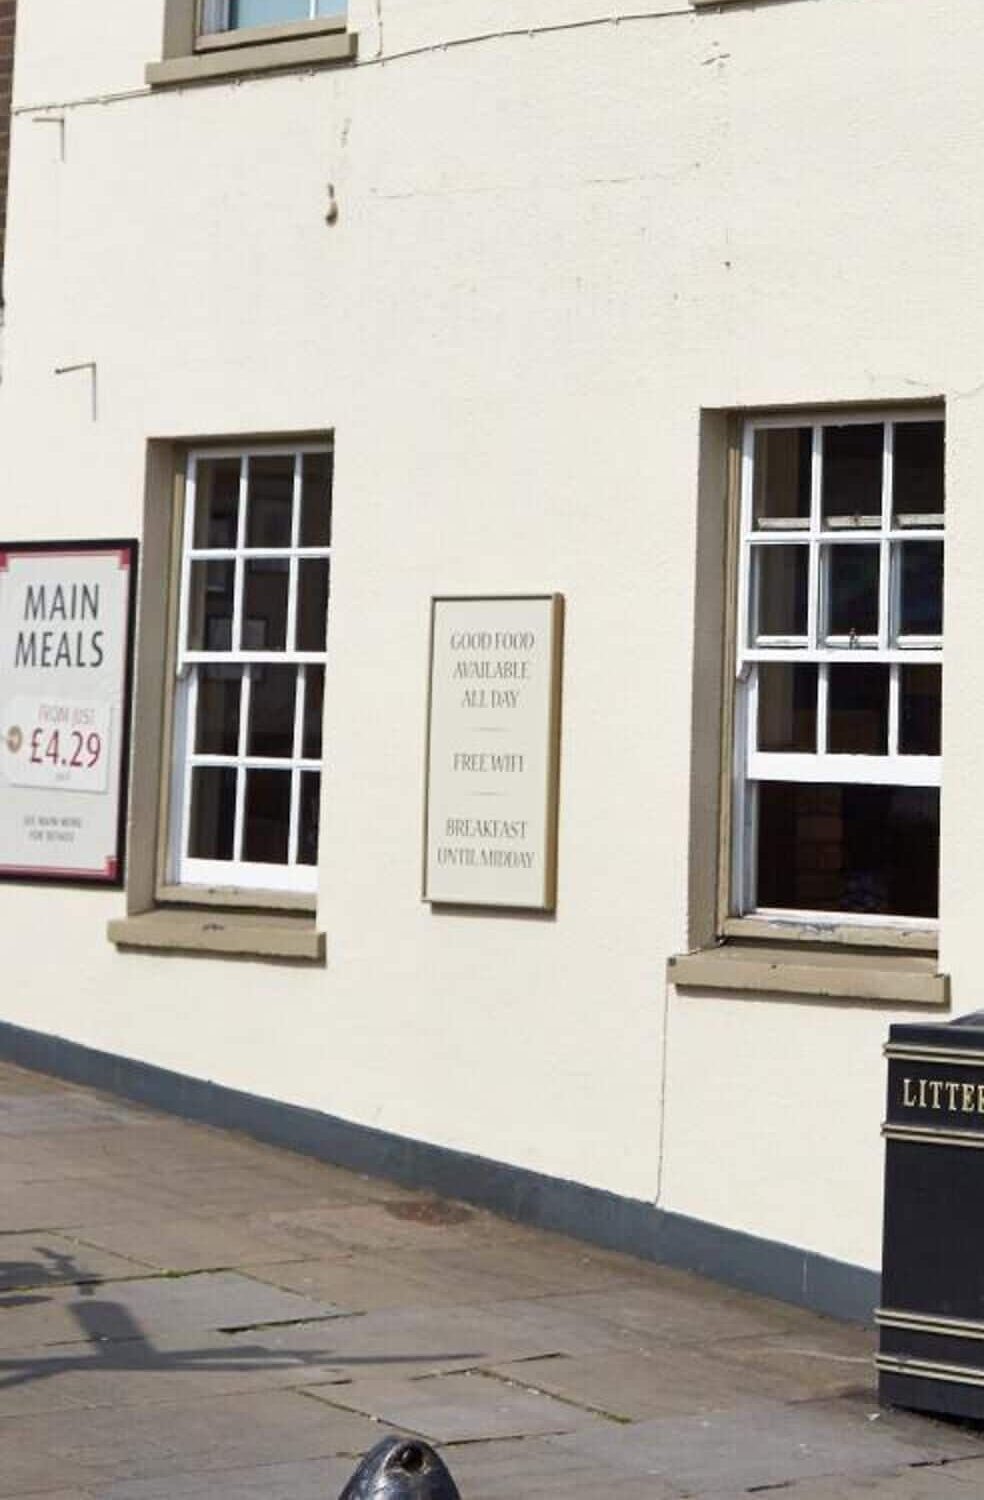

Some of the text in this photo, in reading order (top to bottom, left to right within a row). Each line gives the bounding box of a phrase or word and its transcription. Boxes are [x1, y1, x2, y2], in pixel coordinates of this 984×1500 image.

[24, 583, 101, 621] MAIN
[14, 630, 104, 668] MEALS
[450, 631, 535, 650] GOOD FOOD
[452, 661, 530, 679] AVAILABLE
[461, 689, 520, 708] ALL DAY
[30, 727, 102, 768] £4.29
[453, 753, 487, 772] FREE
[446, 818, 528, 839] BREAKFAST
[437, 847, 536, 869] UNTIL MIDDAY
